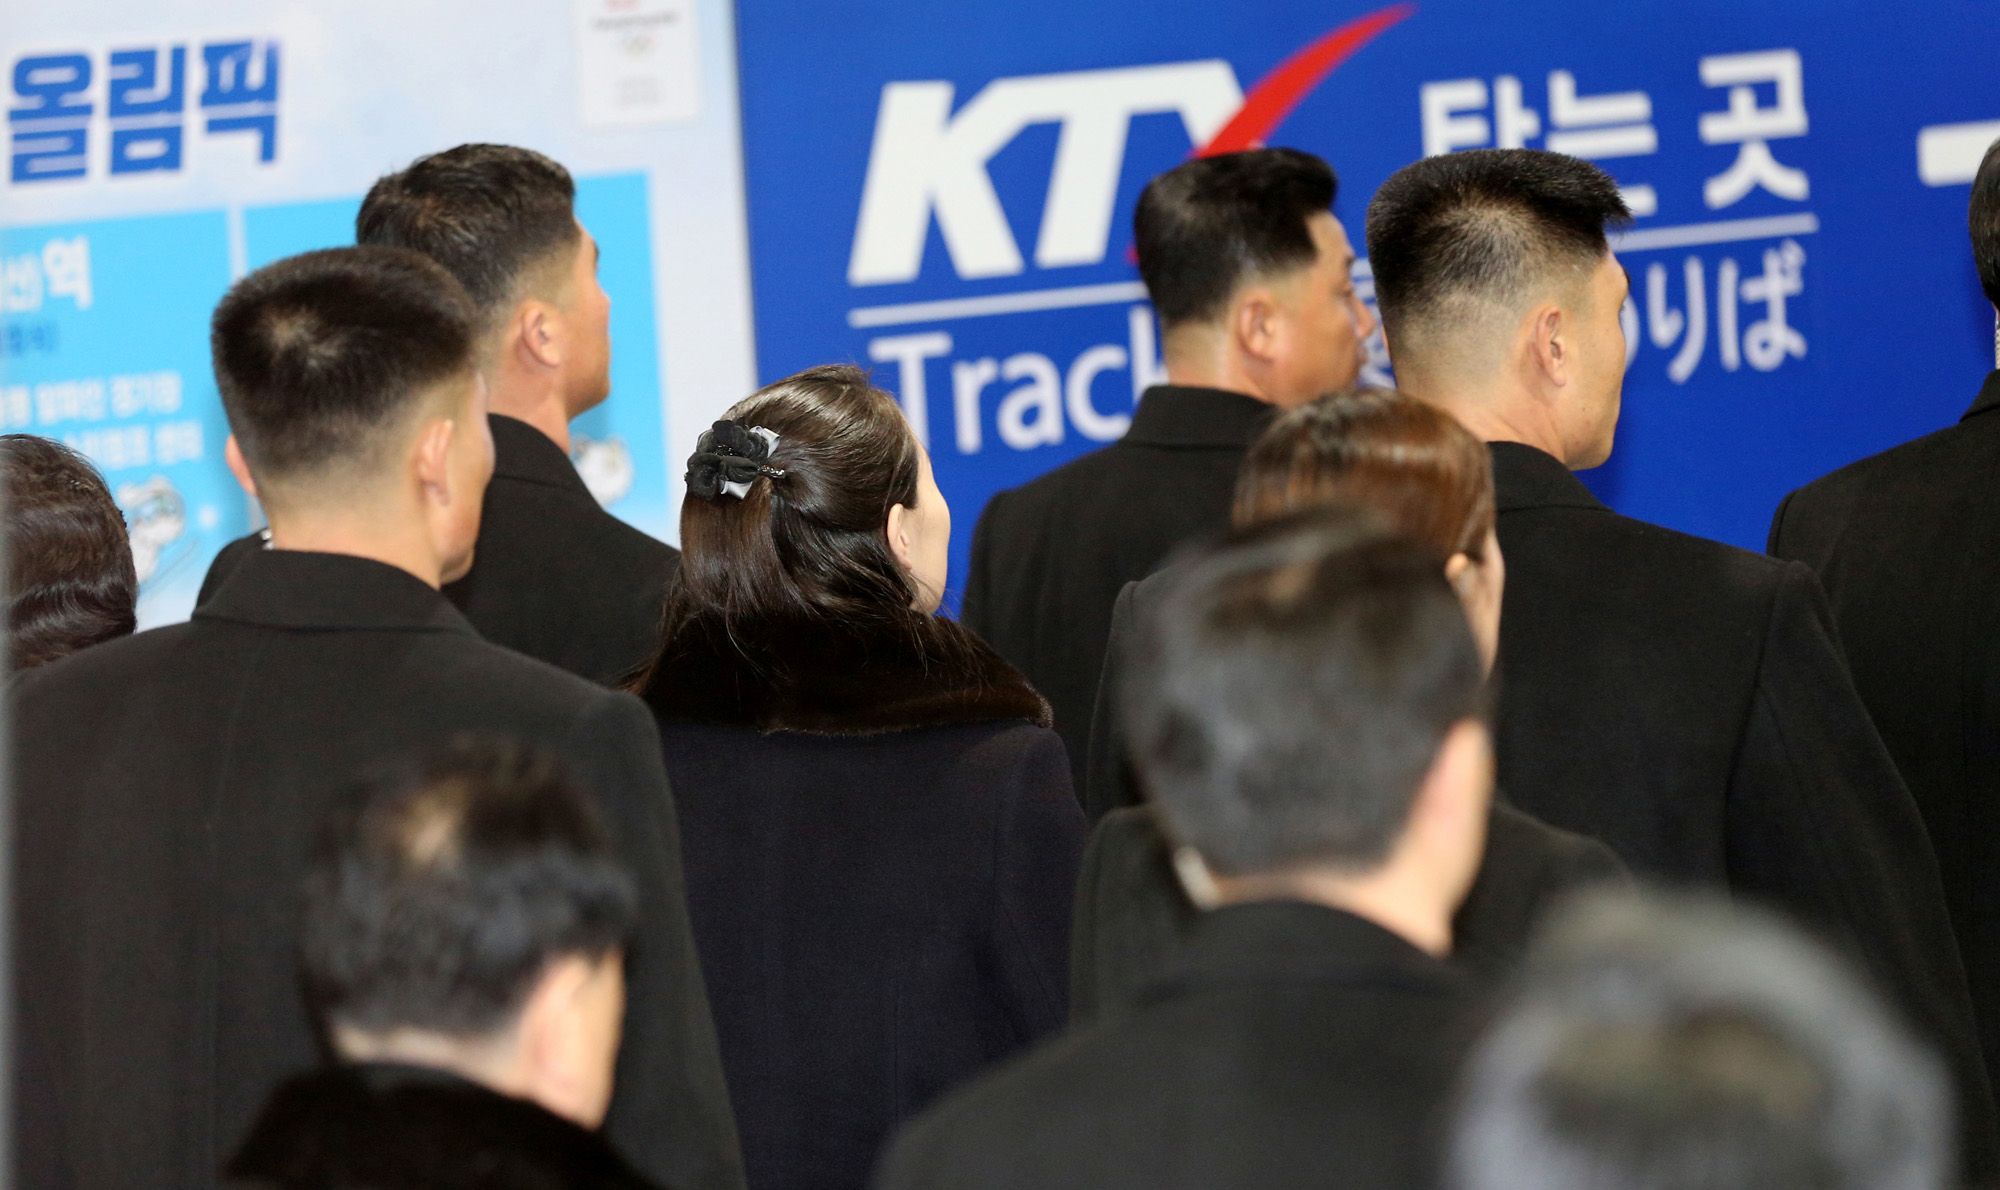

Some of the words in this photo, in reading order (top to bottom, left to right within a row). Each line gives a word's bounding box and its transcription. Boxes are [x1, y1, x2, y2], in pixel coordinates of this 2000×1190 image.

[8, 39, 281, 184] 올림픽
[1421, 69, 1658, 217] 타는
[1699, 48, 1809, 210] 곳
[1620, 238, 1808, 386] りば
